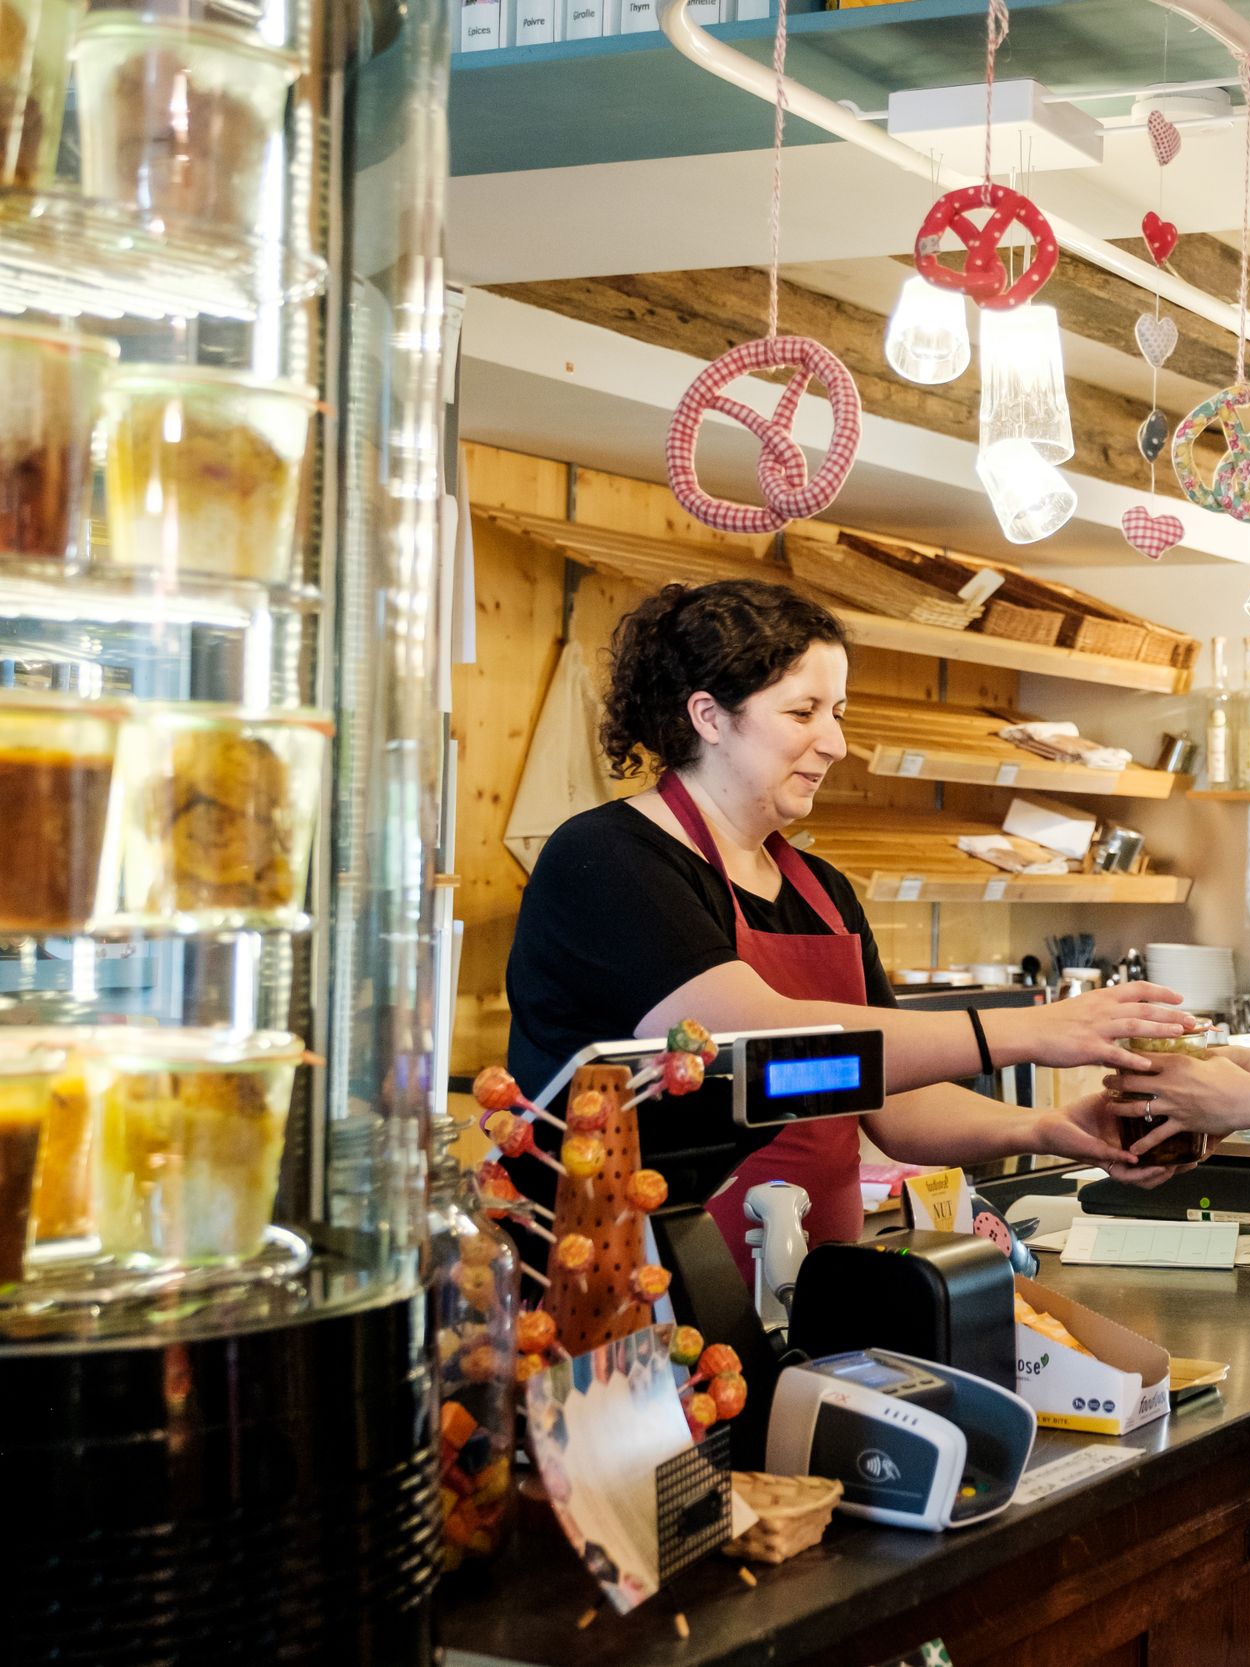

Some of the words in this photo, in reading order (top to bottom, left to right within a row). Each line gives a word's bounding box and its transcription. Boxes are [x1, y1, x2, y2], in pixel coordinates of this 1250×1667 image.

[630, 2, 650, 13] Thym
[523, 17, 546, 28] Poivre
[932, 1200, 953, 1219] NUT
[1017, 1359, 1041, 1376] ose
